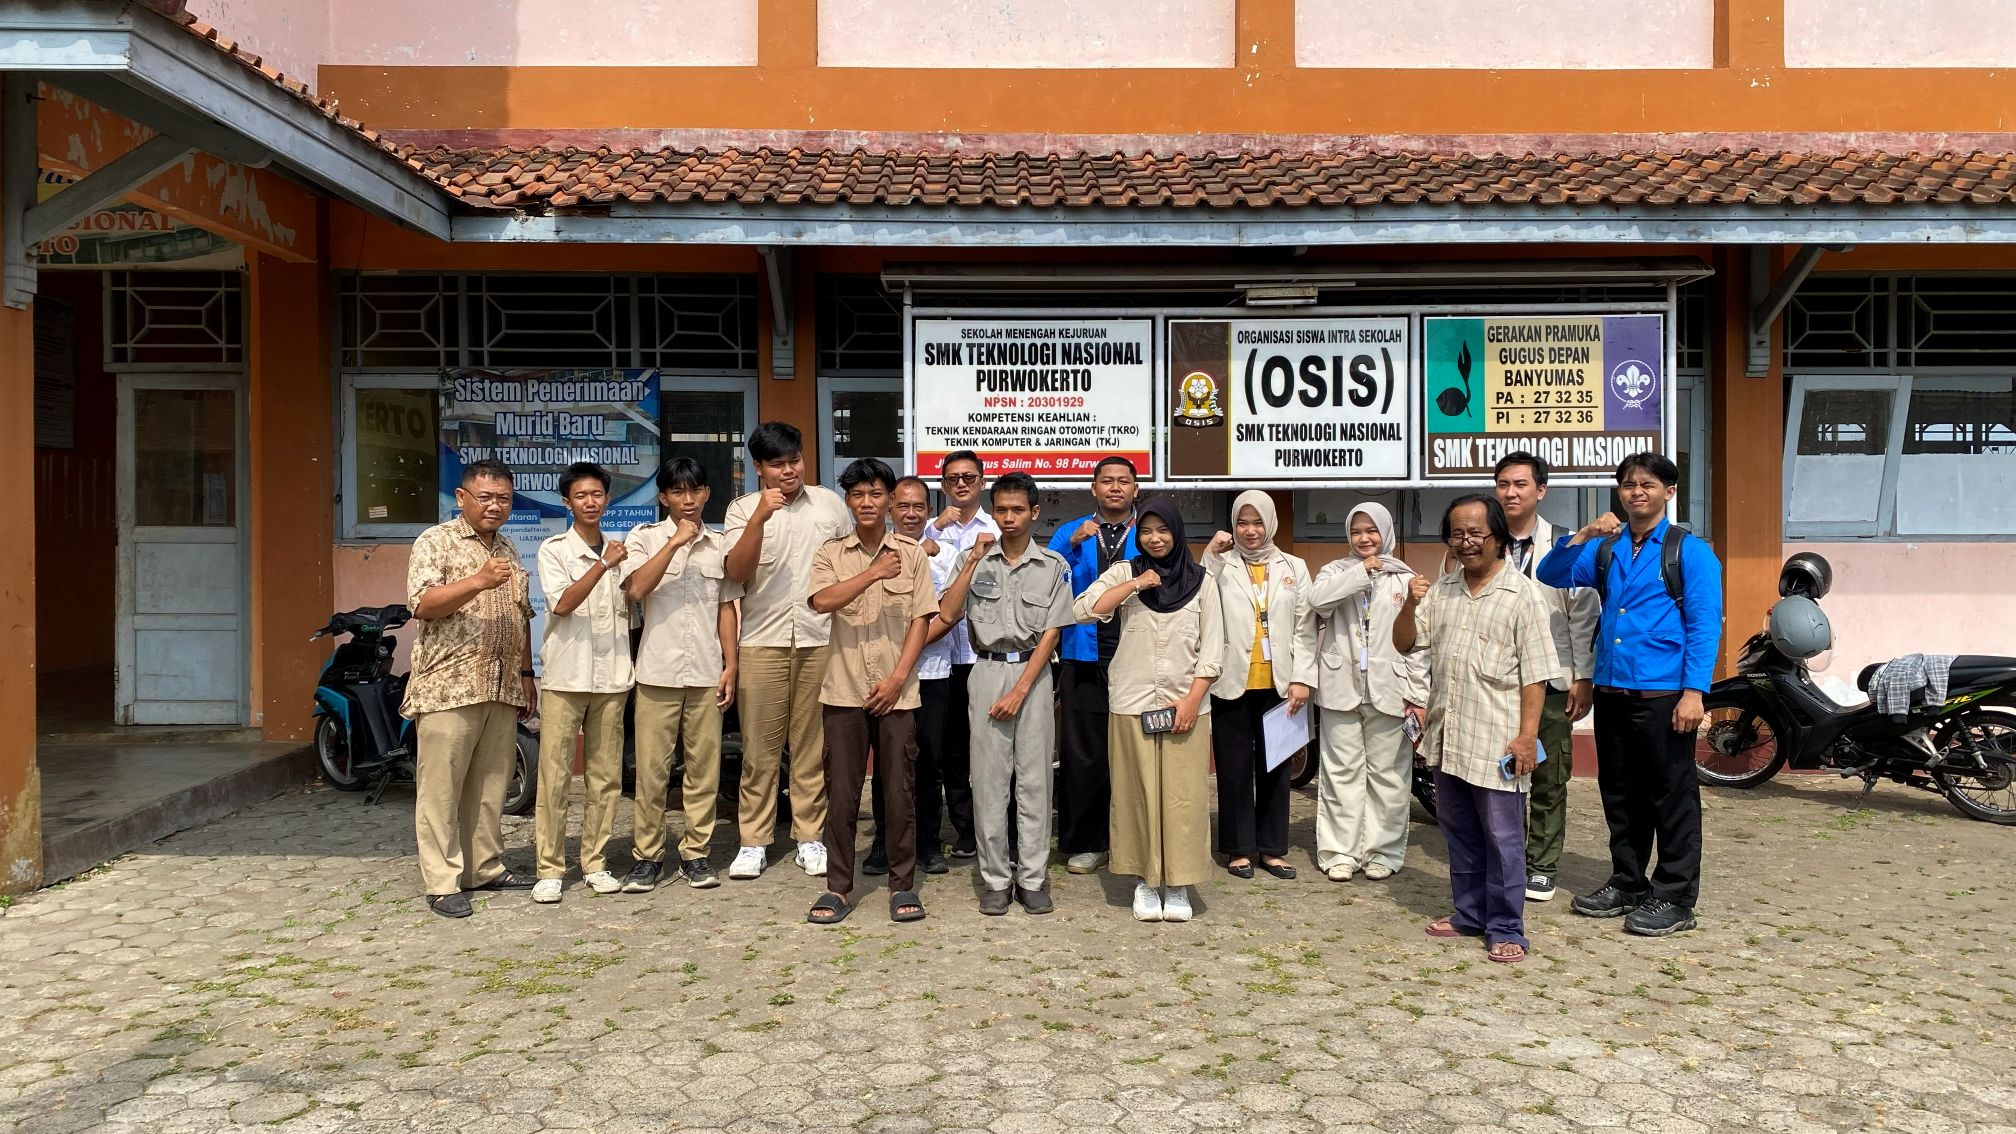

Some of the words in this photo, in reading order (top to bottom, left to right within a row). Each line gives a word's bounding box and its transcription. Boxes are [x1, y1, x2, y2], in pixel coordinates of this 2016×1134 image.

[961, 328, 1002, 339] SEKOLAH
[1005, 328, 1056, 339] MENENGAH
[1058, 327, 1107, 339] KEJURUAN
[1237, 330, 1294, 344] ORGANISASI
[1296, 330, 1326, 344] SISWA
[1328, 330, 1356, 344] INTRA
[1358, 329, 1402, 343] SEKOLAH
[1487, 325, 1542, 343] GERAKAN
[1545, 324, 1600, 342] PRAMUKA
[924, 342, 963, 366] SMK
[966, 342, 1057, 366] TEKNOLOGI
[1061, 341, 1143, 365] NASIONAL
[1499, 347, 1544, 365] GUGUS
[1549, 346, 1590, 364] DEPAN
[976, 368, 1092, 392] PURWOKERTO
[1244, 347, 1395, 415] (OSIS)
[1504, 368, 1585, 387] BANYUMAS
[454, 377, 522, 402] Sistem
[526, 377, 645, 402] Penerimaan
[1495, 391, 1515, 404] PA
[1520, 394, 1525, 404] :
[1533, 391, 1550, 404] 27
[1555, 391, 1572, 403] 32
[1576, 390, 1593, 403] 35
[984, 397, 1017, 408] NPSN
[1020, 398, 1024, 407] :
[1027, 396, 1084, 407] 20301929
[495, 411, 551, 437] Murid
[559, 412, 605, 436] Baru
[968, 412, 1035, 423] KOMPETENSI
[1037, 412, 1090, 423] KEAHLIAN
[1093, 414, 1096, 422] :
[1185, 418, 1214, 426] OSIS
[1496, 411, 1510, 424] PI
[1520, 413, 1525, 424] :
[1533, 411, 1550, 424] 27
[1555, 411, 1572, 423] 32
[1576, 410, 1593, 423] 36
[925, 426, 960, 436] TEKNIK
[962, 426, 1018, 435] KENDARAAN
[1021, 426, 1056, 435] RINGAN
[1058, 426, 1105, 435] OTOMOTIF
[1107, 425, 1139, 436] (TKRO)
[1236, 423, 1265, 442] SMK
[1267, 423, 1337, 442] TEKNOLOGI
[1340, 422, 1402, 441] NASIONAL
[944, 437, 979, 447] TEKNIK
[981, 437, 1032, 447] KOMPUTER
[1034, 438, 1041, 447] &
[1044, 437, 1091, 447] JARINGAN
[1095, 437, 1120, 448] (TKJ)
[459, 447, 492, 465] SMK
[494, 447, 568, 465] TEKNOLOGI
[571, 446, 639, 465] NASIONAL
[1274, 448, 1364, 467] PURWOKERTO
[1433, 437, 1473, 468] SMK
[1002, 459, 1032, 469] Salim
[1036, 458, 1052, 469] No.
[1055, 458, 1069, 469] 98
[617, 509, 623, 517] 2
[624, 509, 653, 517] TAHUN
